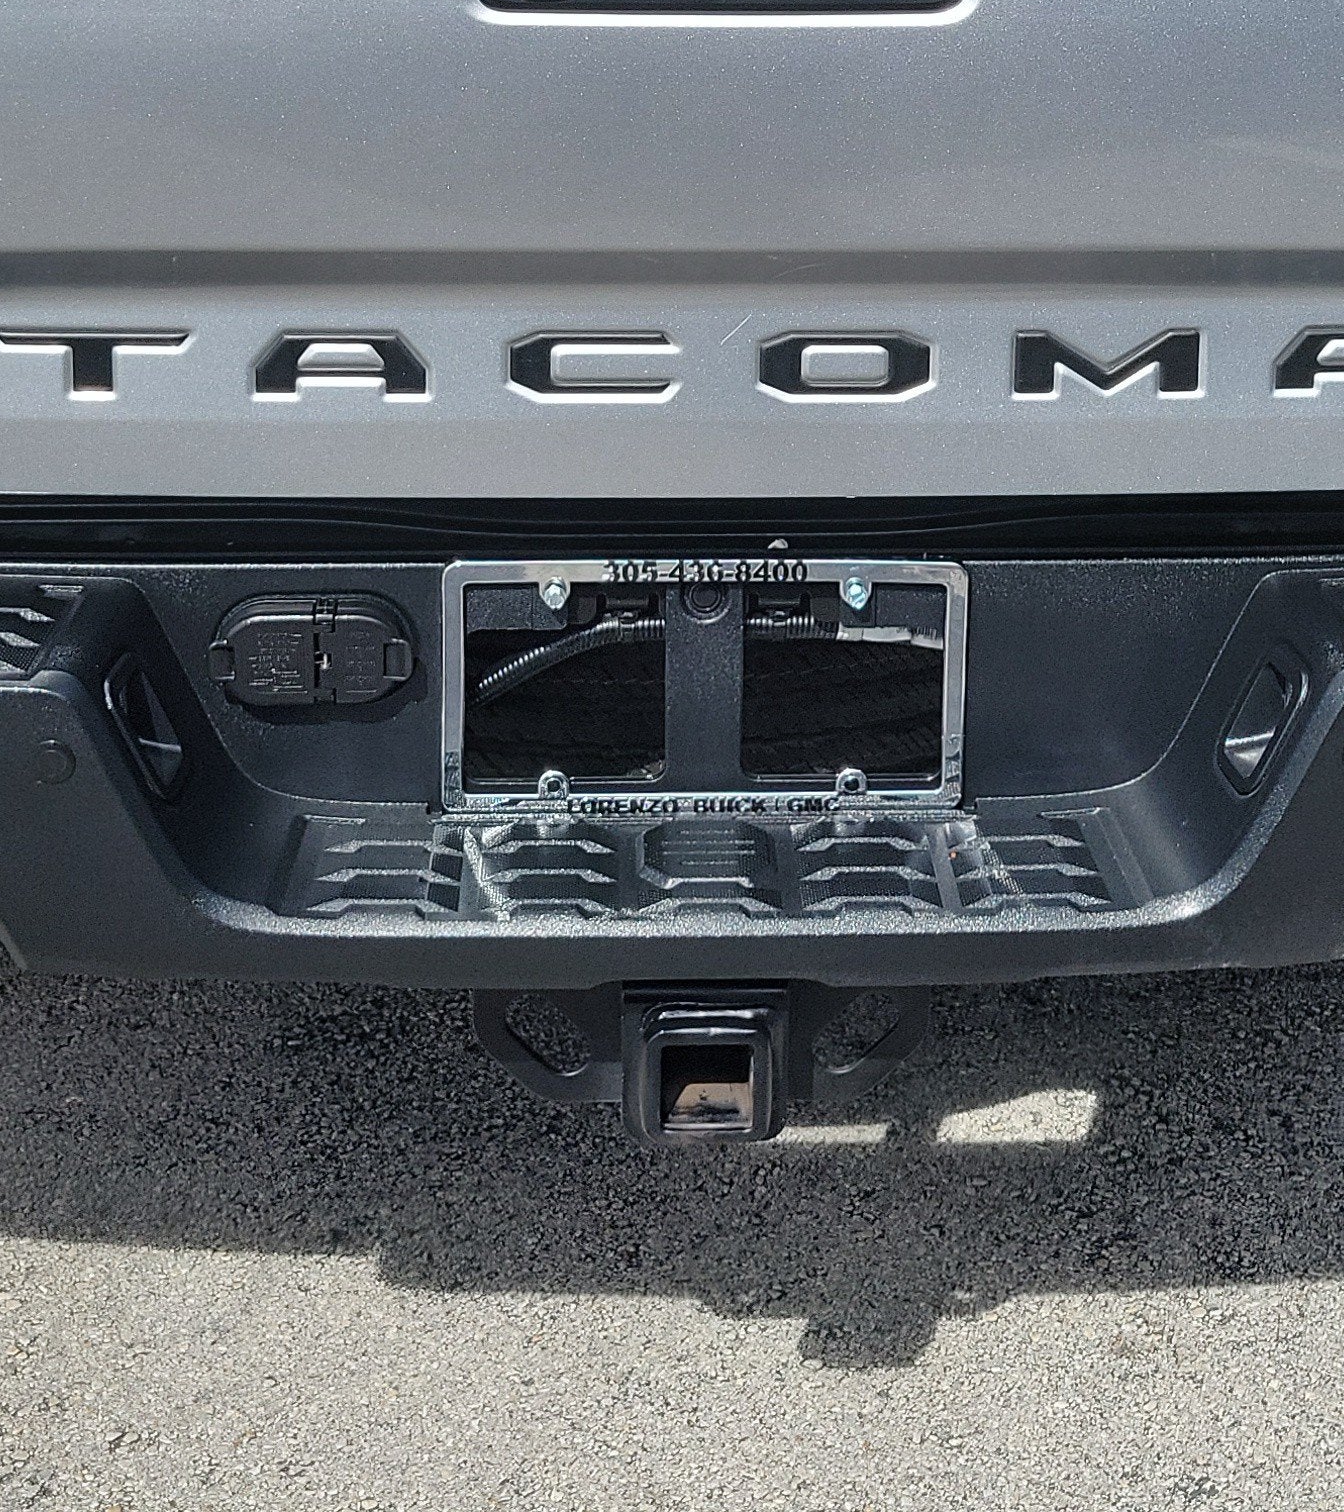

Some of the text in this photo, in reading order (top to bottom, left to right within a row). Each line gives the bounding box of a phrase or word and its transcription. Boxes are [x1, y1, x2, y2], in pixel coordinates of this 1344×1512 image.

[603, 558, 808, 583] 305-436-8400
[567, 794, 840, 814] LORENZO BUICK GMC
